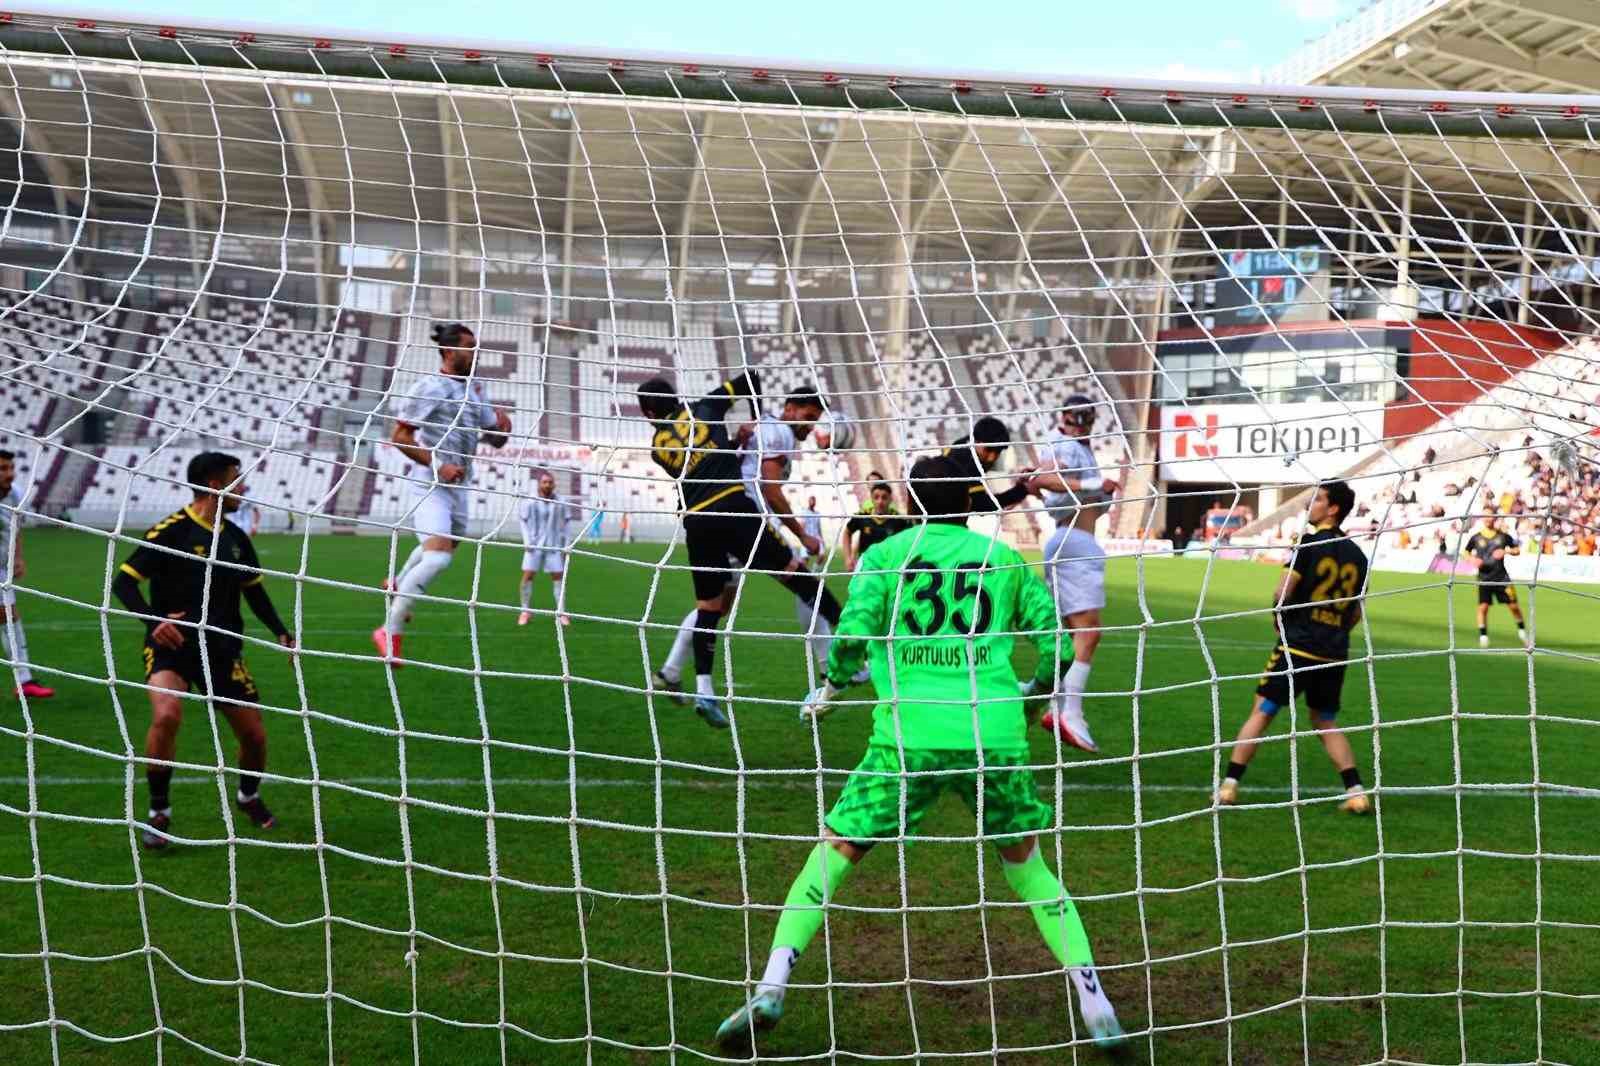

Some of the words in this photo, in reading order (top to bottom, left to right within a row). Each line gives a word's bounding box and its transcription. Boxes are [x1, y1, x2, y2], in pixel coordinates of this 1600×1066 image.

[1235, 426, 1360, 459] Tekpen
[903, 559, 992, 636] 35
[1311, 556, 1358, 610] 23
[901, 645, 961, 668] KURTULUŞ
